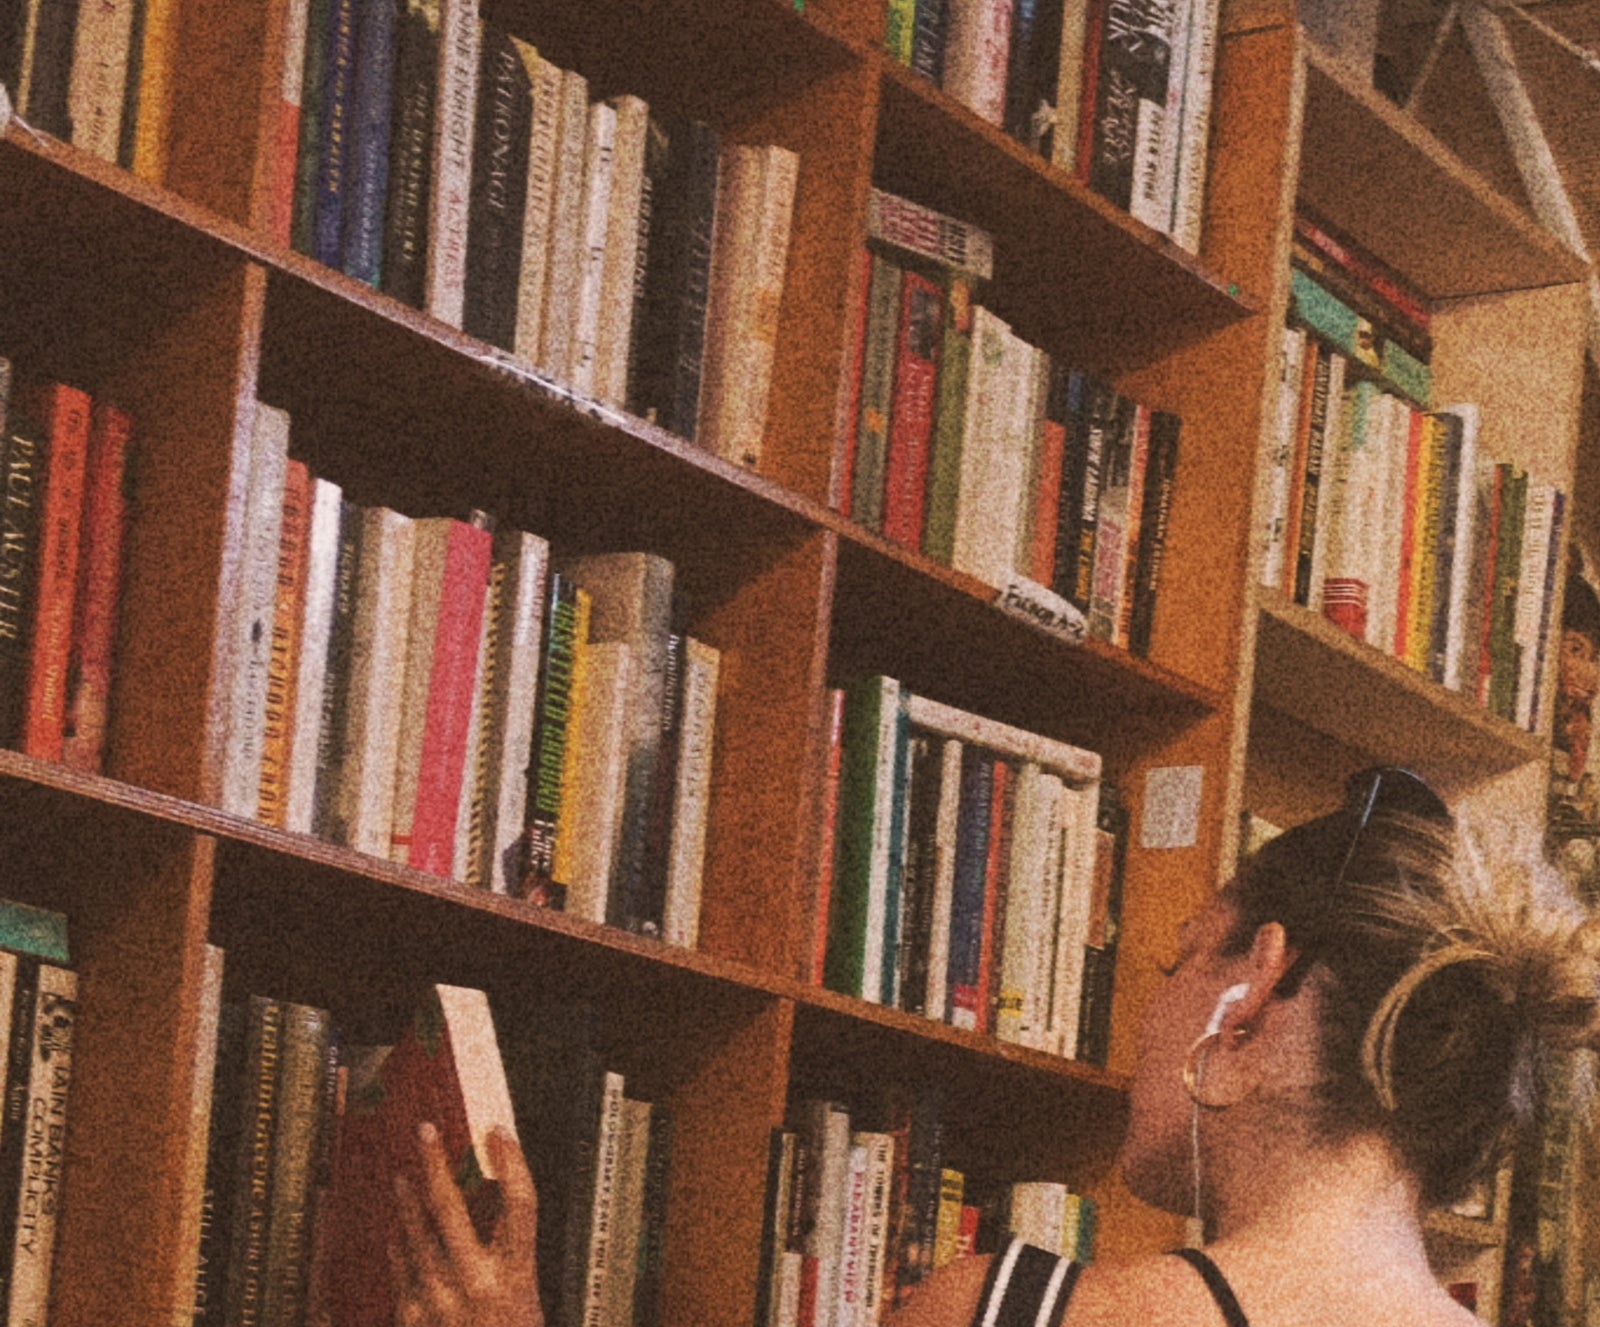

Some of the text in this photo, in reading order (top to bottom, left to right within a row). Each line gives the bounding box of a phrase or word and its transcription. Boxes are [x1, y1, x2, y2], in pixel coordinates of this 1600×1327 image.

[257, 1004, 281, 1110] Graham
[20, 1097, 47, 1258] COMPLICITY
[41, 1065, 70, 1216] IAIN BANKS
